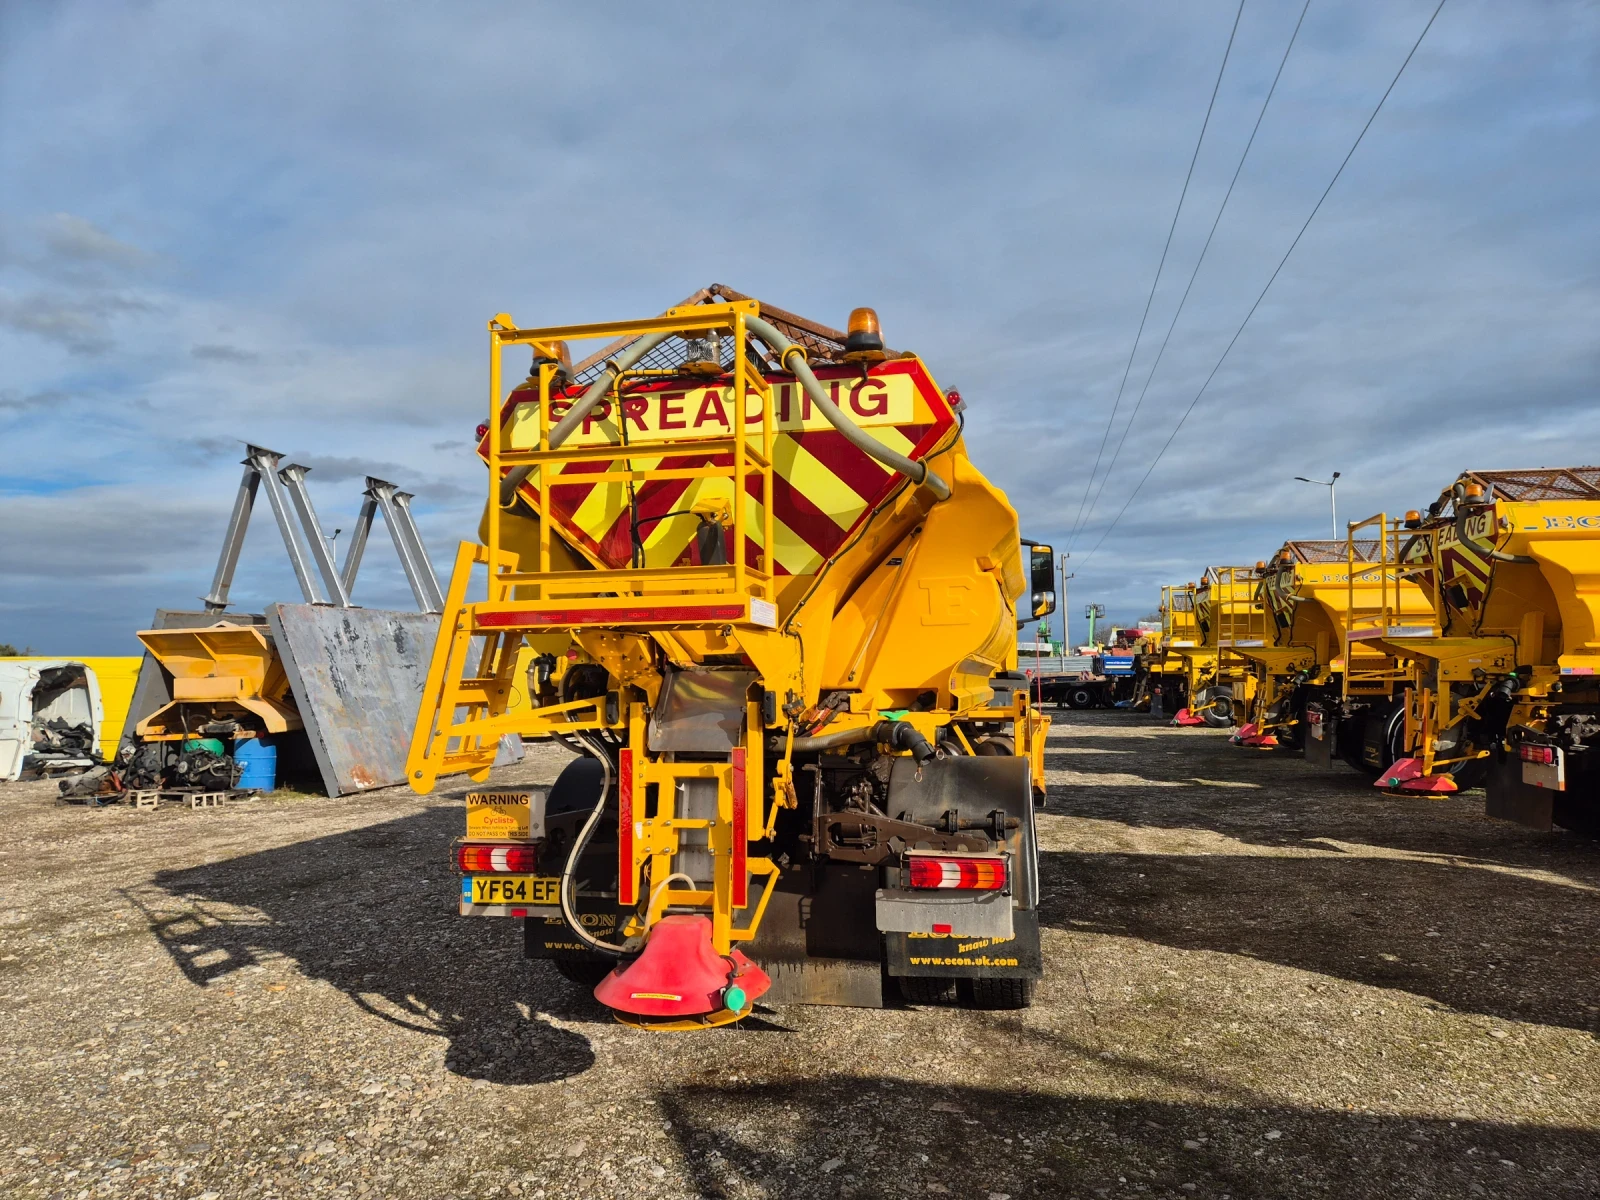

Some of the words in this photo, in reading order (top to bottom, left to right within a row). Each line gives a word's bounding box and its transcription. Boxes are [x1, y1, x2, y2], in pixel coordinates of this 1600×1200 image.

[468, 794, 529, 805] WARNING
[483, 816, 515, 825] Cyclists
[476, 880, 526, 899] YF64
[533, 881, 561, 900] EF
[544, 914, 617, 926] EON
[958, 939, 989, 953] know
[910, 956, 1018, 966] www.econ.uk.com
